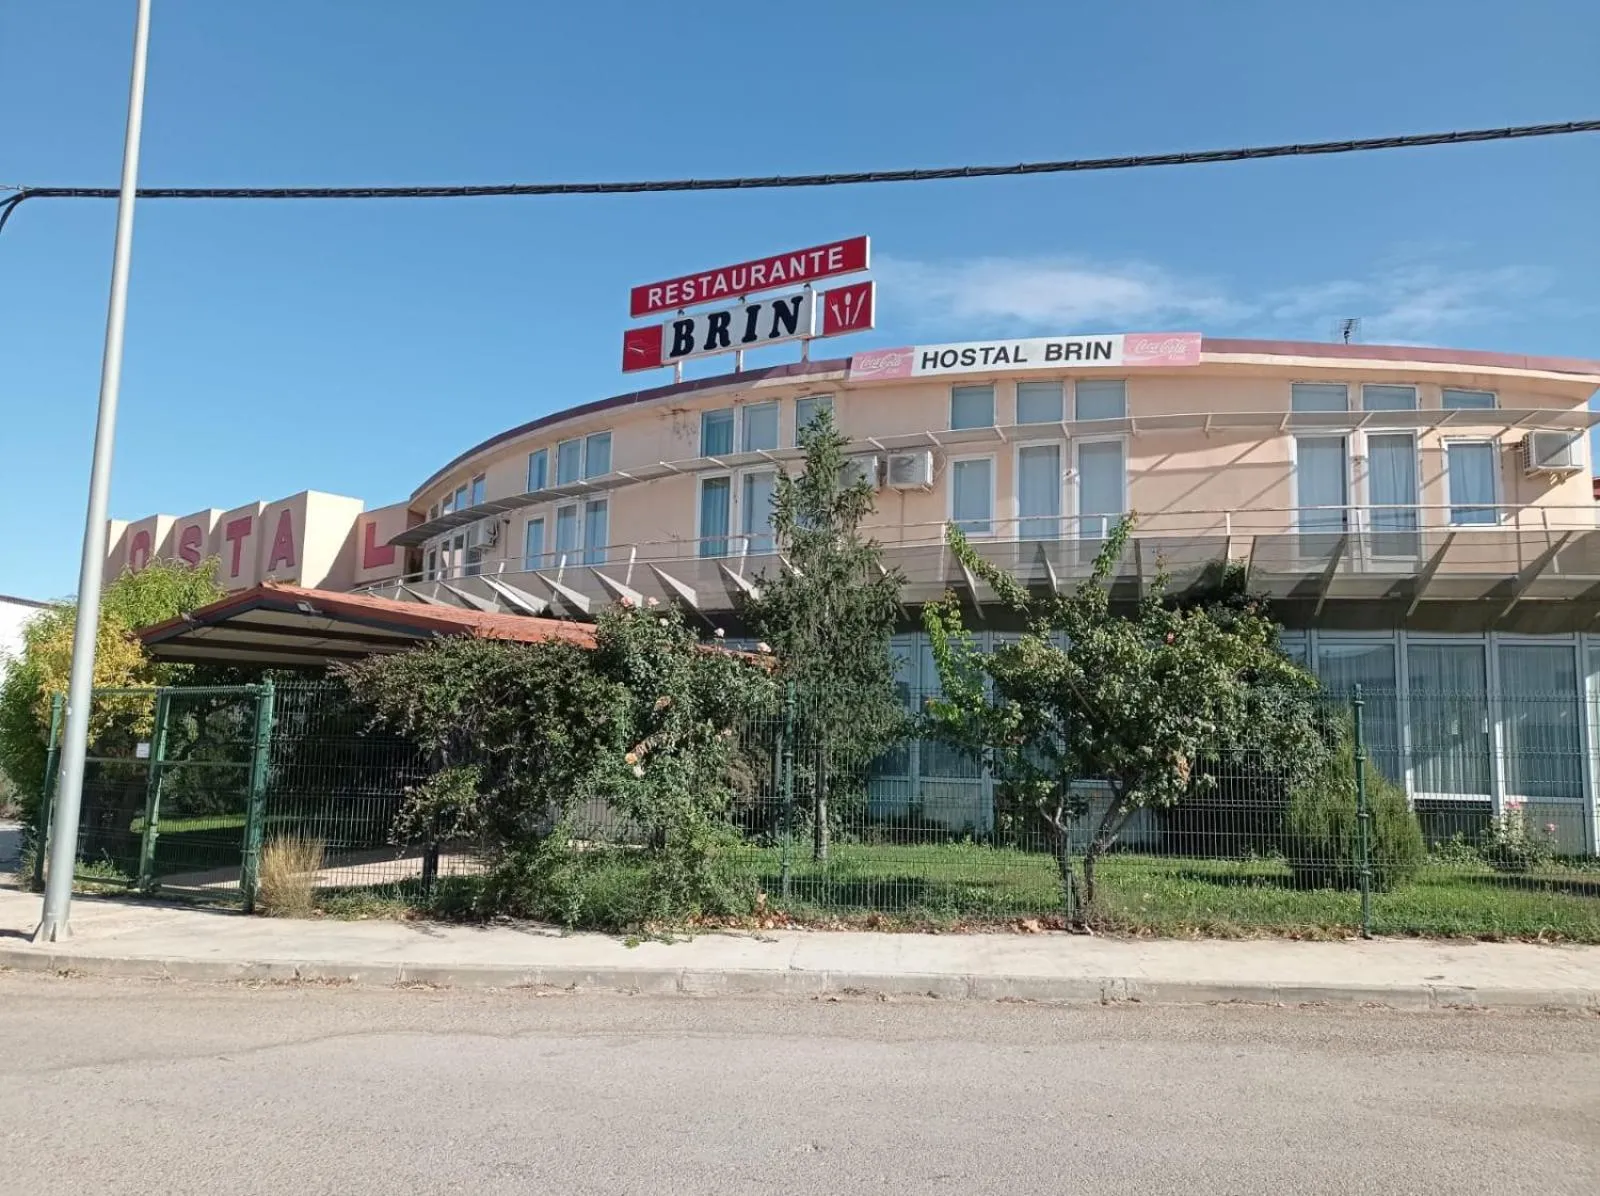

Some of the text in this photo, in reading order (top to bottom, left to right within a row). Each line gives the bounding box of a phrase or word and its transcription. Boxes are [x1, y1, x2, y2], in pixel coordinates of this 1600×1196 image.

[648, 246, 844, 309] RESTAURANTE
[669, 295, 804, 358] BRIN
[920, 341, 1113, 370] HOSTAL BRIN
[129, 508, 396, 578] OSTAL
